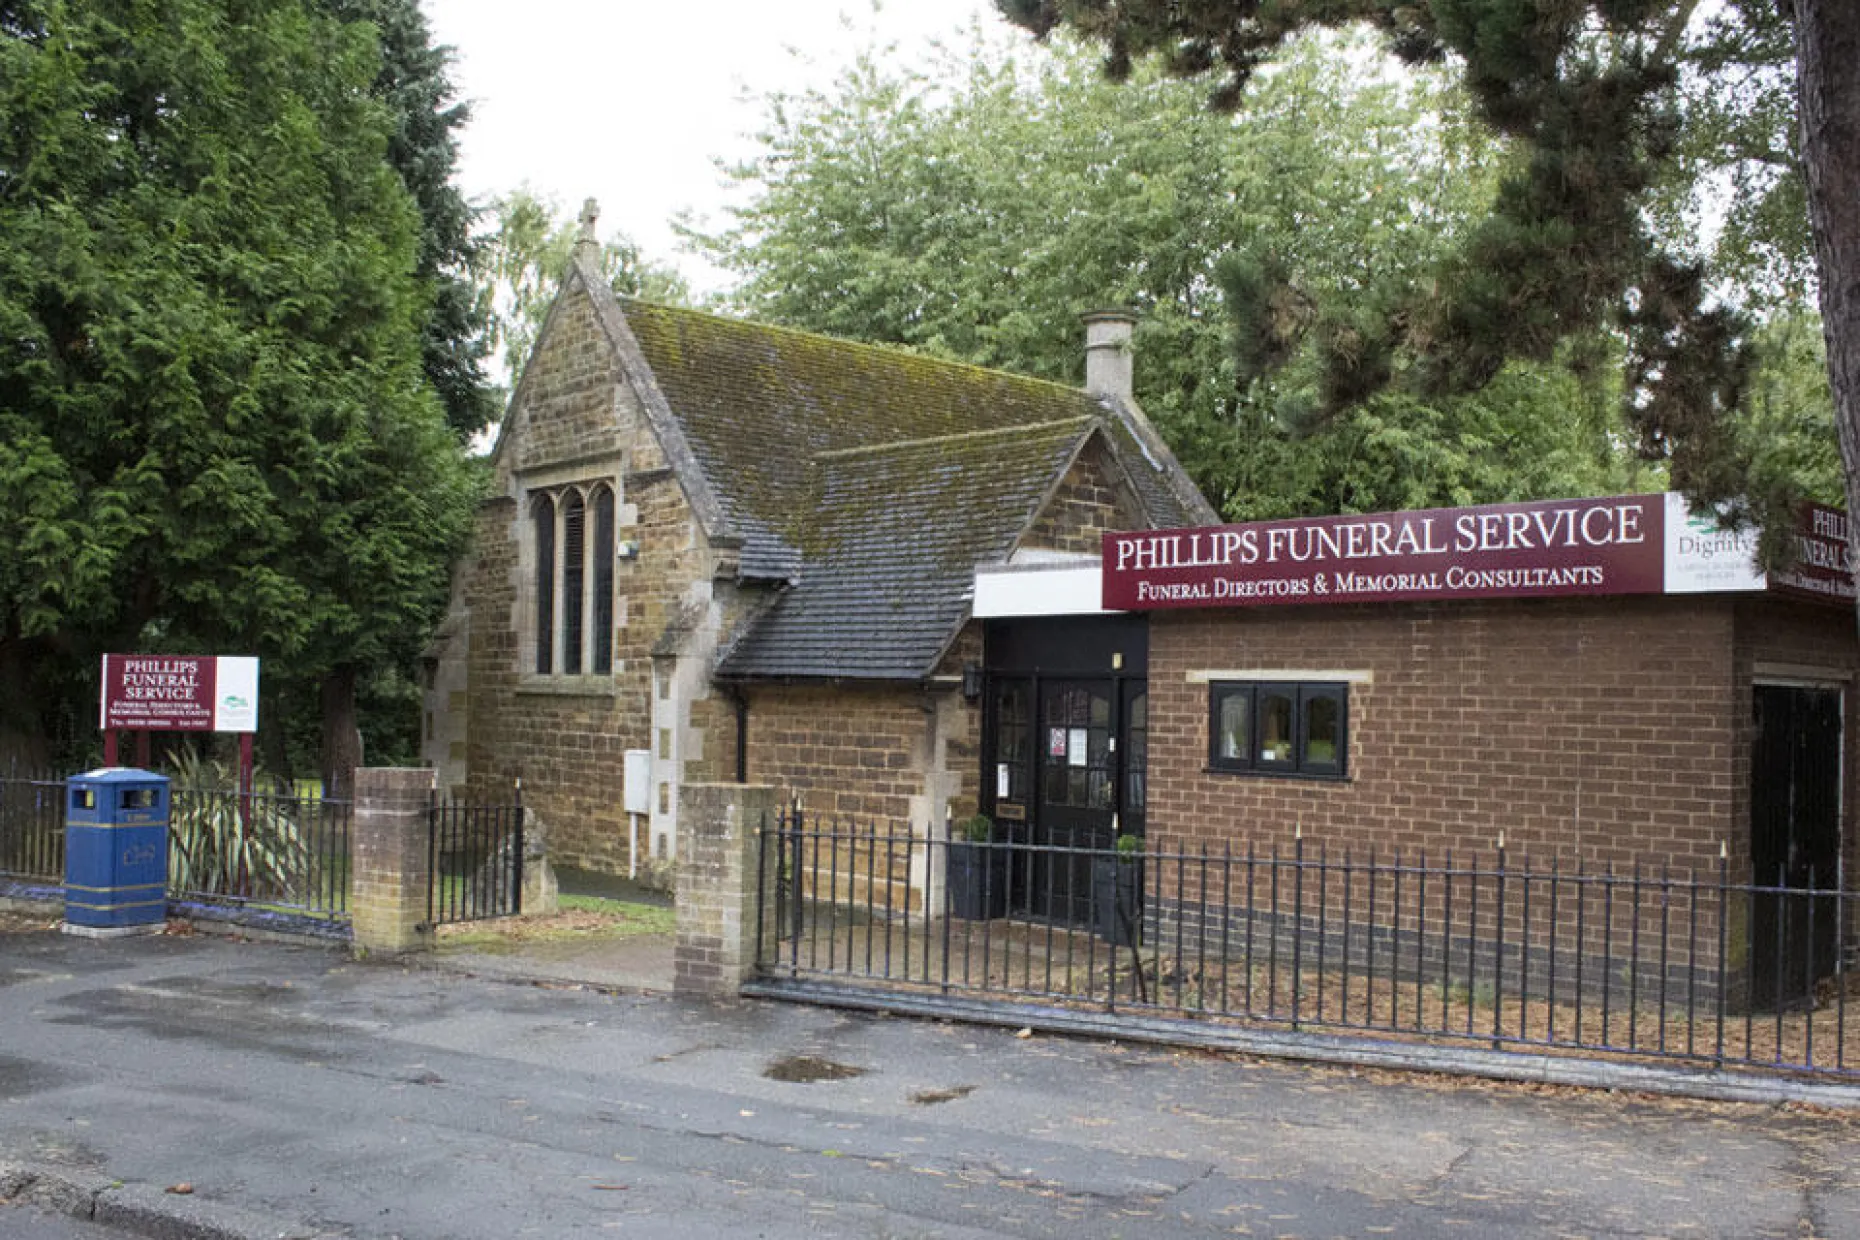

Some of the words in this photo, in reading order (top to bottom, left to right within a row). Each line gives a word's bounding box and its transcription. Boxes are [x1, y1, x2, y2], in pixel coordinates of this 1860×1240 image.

[1115, 529, 1259, 571] PHILLIPS
[1266, 518, 1448, 563] FUNERAL
[1455, 505, 1645, 553] SERVICE
[1137, 580, 1211, 602] FUNERAL
[1213, 577, 1309, 599] DIRECTORS
[1313, 572, 1330, 595] &
[1334, 571, 1443, 594] MEMORIAL
[1446, 565, 1604, 590] CONSULTANTS
[125, 660, 199, 673] PHILLIPS
[123, 673, 200, 687] FUNERAL
[125, 686, 195, 699] SERVICE
